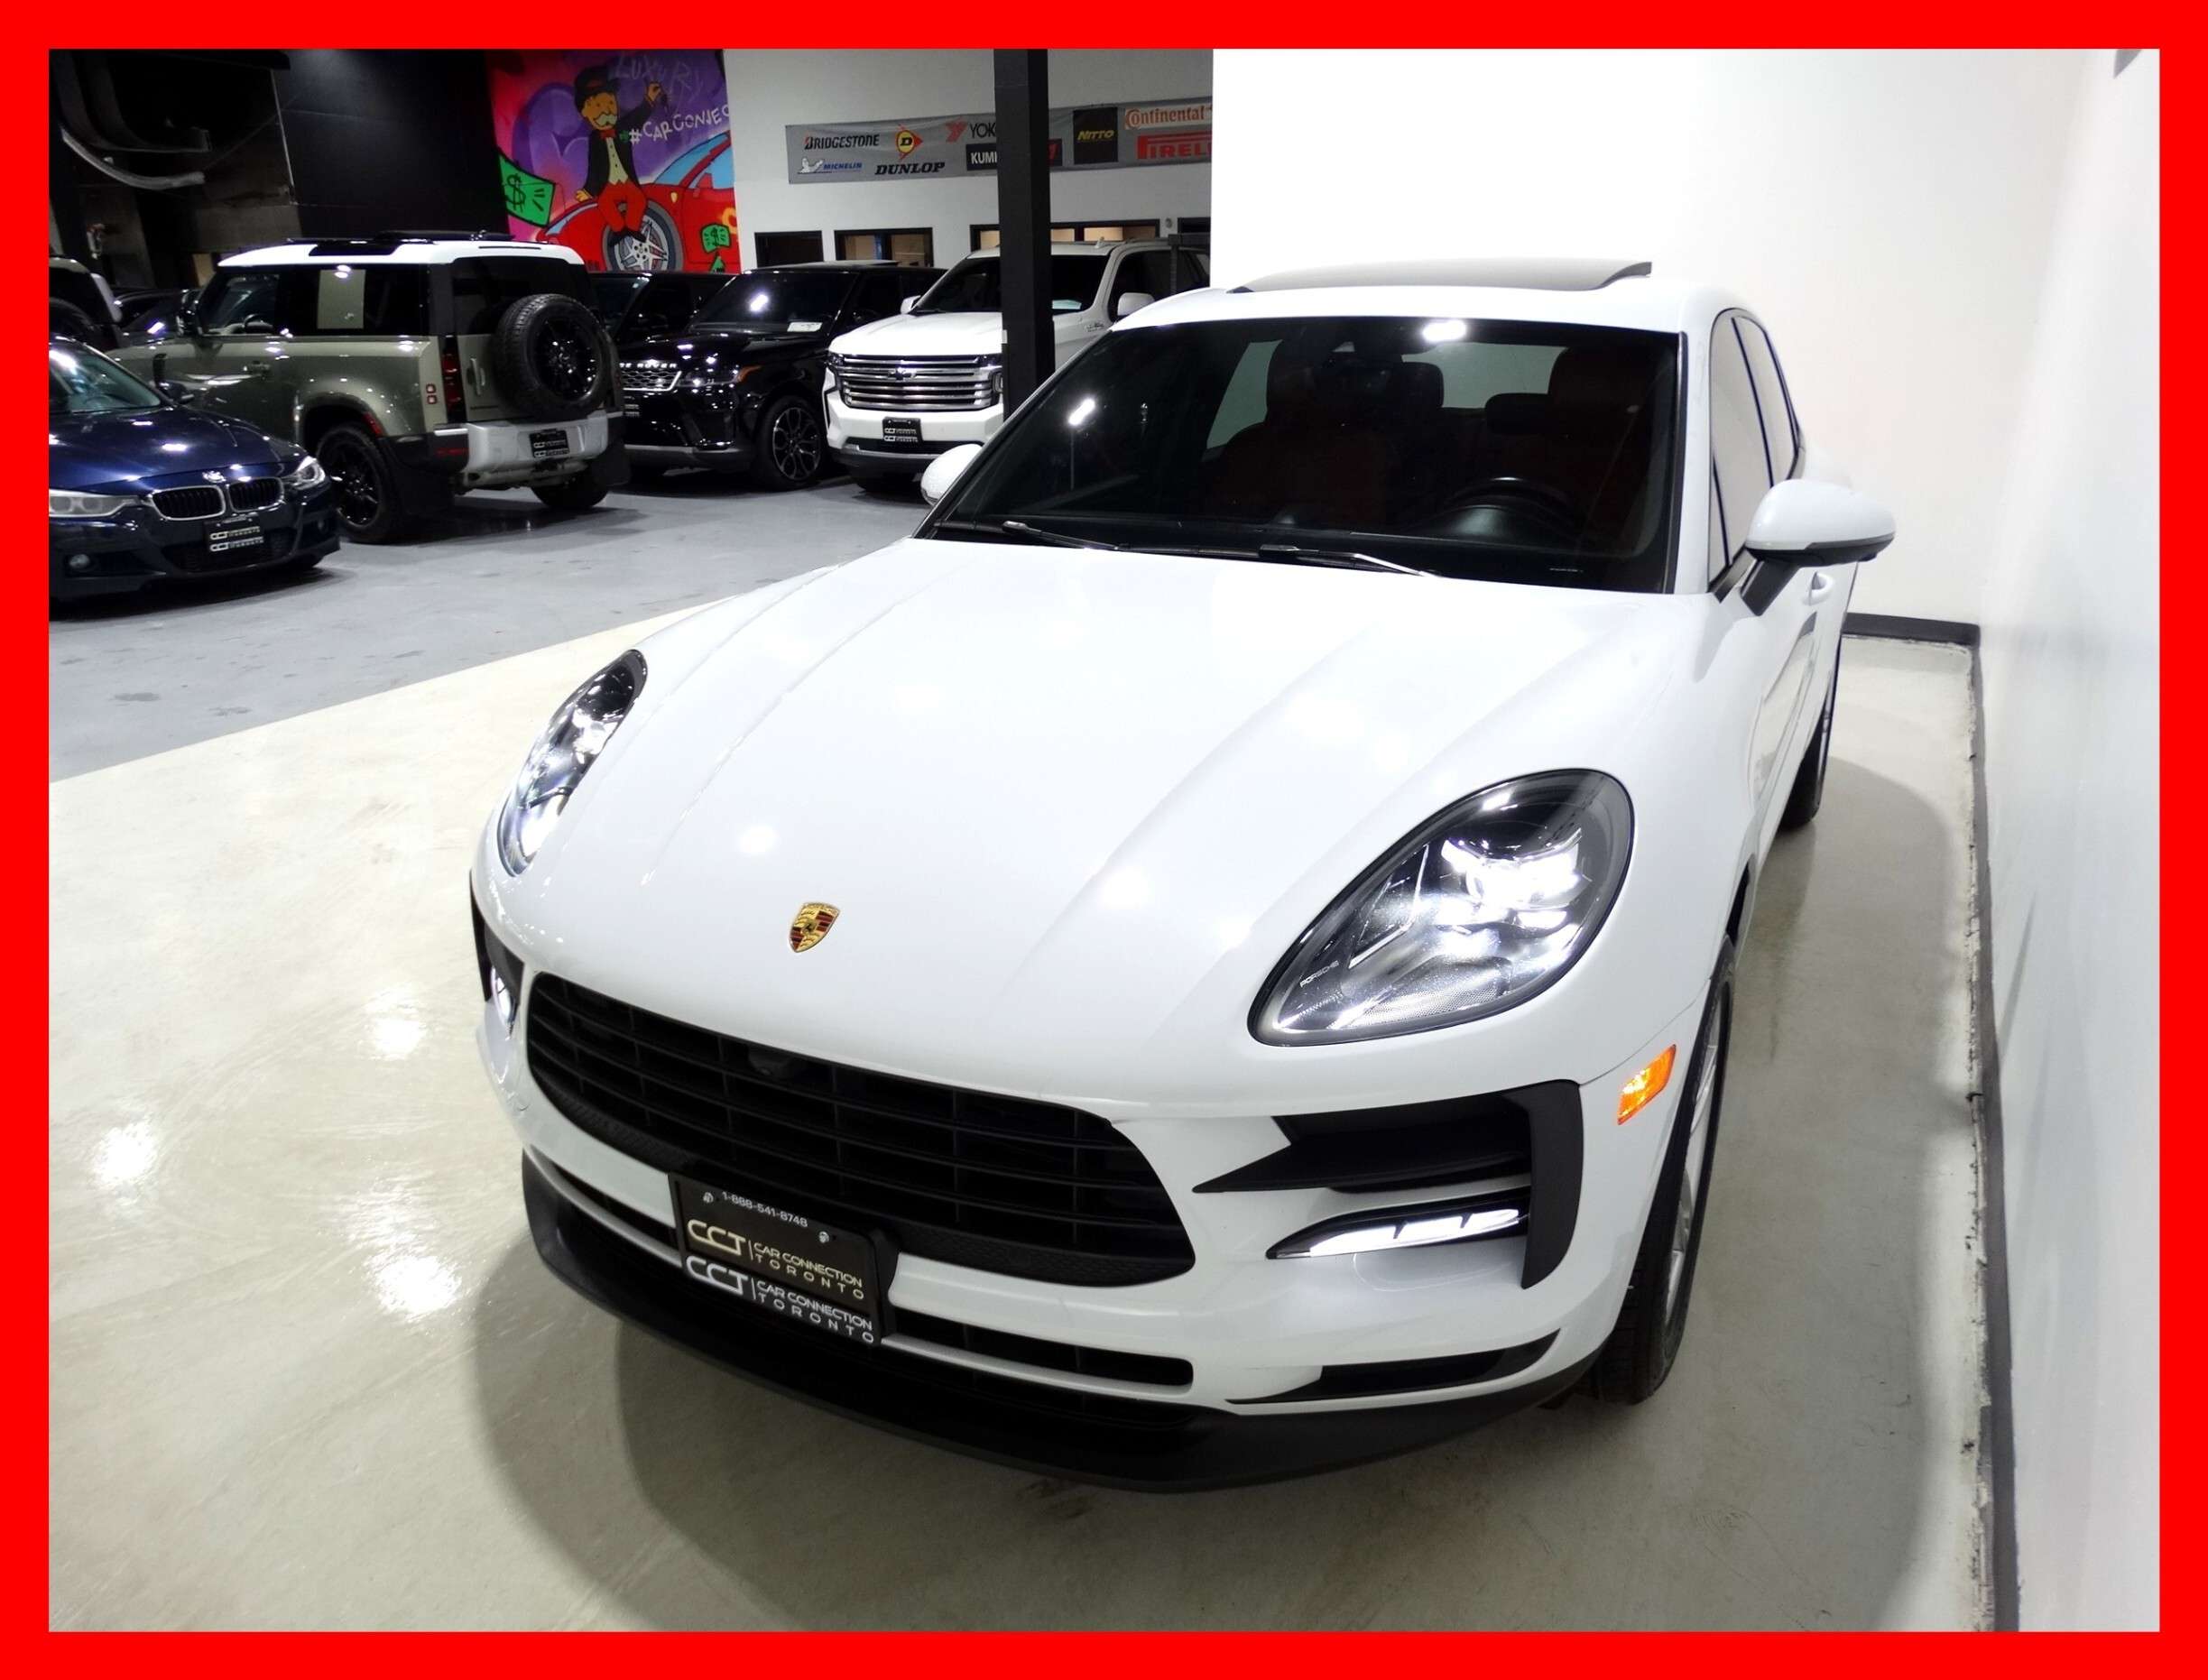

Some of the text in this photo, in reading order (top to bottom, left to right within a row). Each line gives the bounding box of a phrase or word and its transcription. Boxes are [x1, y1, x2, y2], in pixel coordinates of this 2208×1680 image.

[1125, 106, 1206, 129] Continental
[804, 134, 881, 150] BRIDGESTONE
[1077, 130, 1115, 141] NITTO
[823, 162, 864, 171] MICHELIN
[874, 162, 946, 175] DUNLOP
[1299, 960, 1340, 988] PORSCHE
[687, 1219, 746, 1256] CCT
[686, 1255, 749, 1296] CCT
[753, 1242, 863, 1288] CAR CONNECTION
[754, 1253, 864, 1300] TORONTO
[756, 1279, 873, 1332] CAR CONNECTION
[757, 1291, 874, 1343] TORONTO
